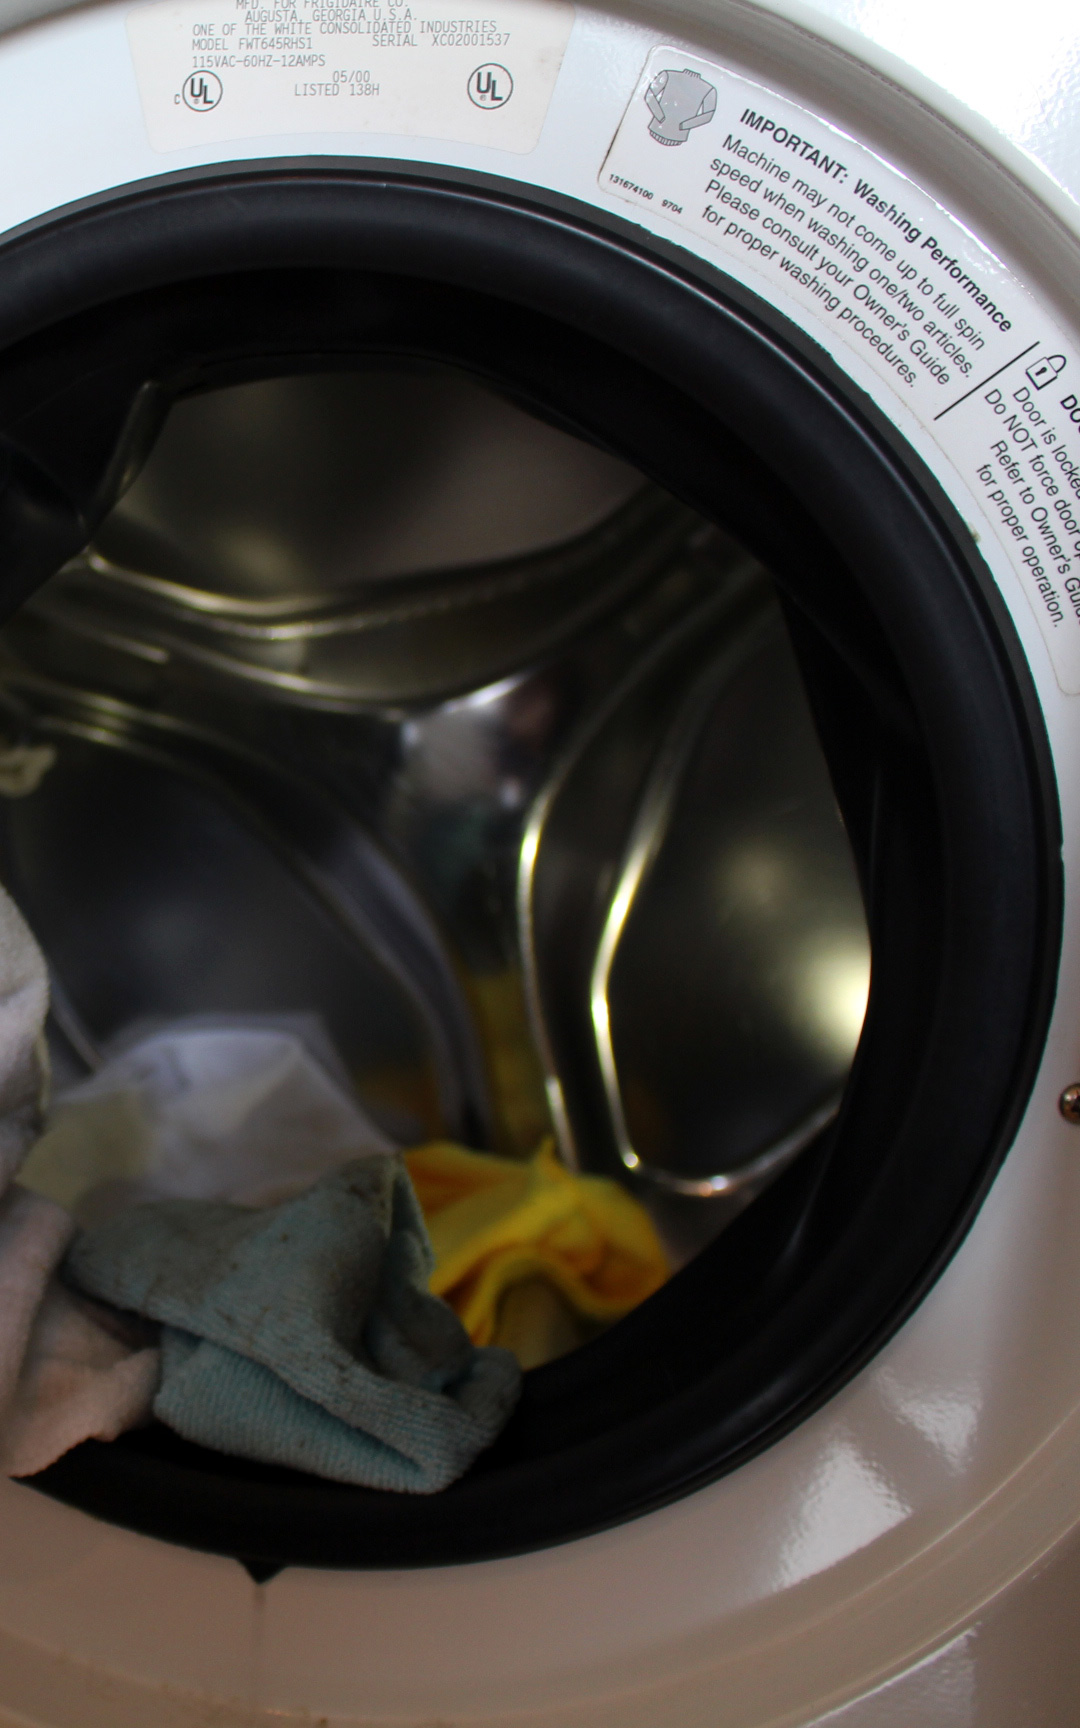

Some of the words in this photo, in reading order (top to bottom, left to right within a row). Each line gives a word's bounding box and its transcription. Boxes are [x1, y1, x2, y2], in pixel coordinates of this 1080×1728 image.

[192, 23, 215, 36] ONE
[222, 23, 237, 36] OF
[245, 22, 267, 35] THE
[274, 22, 312, 35] WHITE
[320, 21, 412, 34] CONSOLIDATED
[419, 20, 497, 33] INDUSTRIES
[236, 0, 264, 9] MFD.
[274, 0, 296, 9] FOR
[304, 0, 380, 8] FRIGIDAIRE
[312, 9, 367, 22] GEORGIA
[373, 8, 418, 21] U.S.A.
[192, 38, 229, 51] MODEL
[238, 37, 313, 50] FWT645RHS1
[372, 34, 418, 47] SERIAL
[192, 54, 326, 68] 115VAC-60HZ-12AMPS
[294, 83, 340, 96] LISTED
[349, 83, 380, 96] 138H
[332, 70, 370, 83] 05/00
[609, 173, 654, 200] 131674100
[661, 199, 683, 214] 9704
[739, 108, 849, 184] IMPORTANT:
[853, 178, 922, 244] Washing
[920, 236, 1012, 333] Performance
[710, 158, 763, 193] speed
[763, 187, 806, 222] when
[807, 217, 870, 272] washing
[869, 268, 925, 321] one/two
[923, 321, 973, 378] articles.
[722, 134, 791, 183] Machine
[791, 178, 828, 208] may
[827, 203, 856, 228] not
[854, 224, 897, 262] come
[896, 260, 918, 280] up
[916, 277, 934, 296] to
[932, 292, 960, 319] full
[954, 318, 985, 351] spin
[701, 205, 726, 226] for
[723, 222, 780, 261] proper
[779, 256, 841, 312] washing
[836, 307, 917, 388] procedures.
[705, 178, 760, 221] Please
[762, 217, 820, 261] consult
[814, 256, 854, 287] your
[853, 284, 911, 342] Owner's
[910, 339, 951, 385] Guide
[1012, 386, 1047, 427] Door
[1040, 427, 1057, 445] is
[984, 388, 1006, 415] Do
[1002, 414, 1038, 452] NOT
[1028, 454, 1059, 496] force
[1054, 499, 1080, 536] door
[990, 440, 1025, 485] Refer
[1019, 486, 1035, 505] to
[1031, 507, 1071, 574] Owner's
[976, 464, 997, 486] for
[987, 490, 1029, 541] proper
[1022, 546, 1064, 627] operation.
